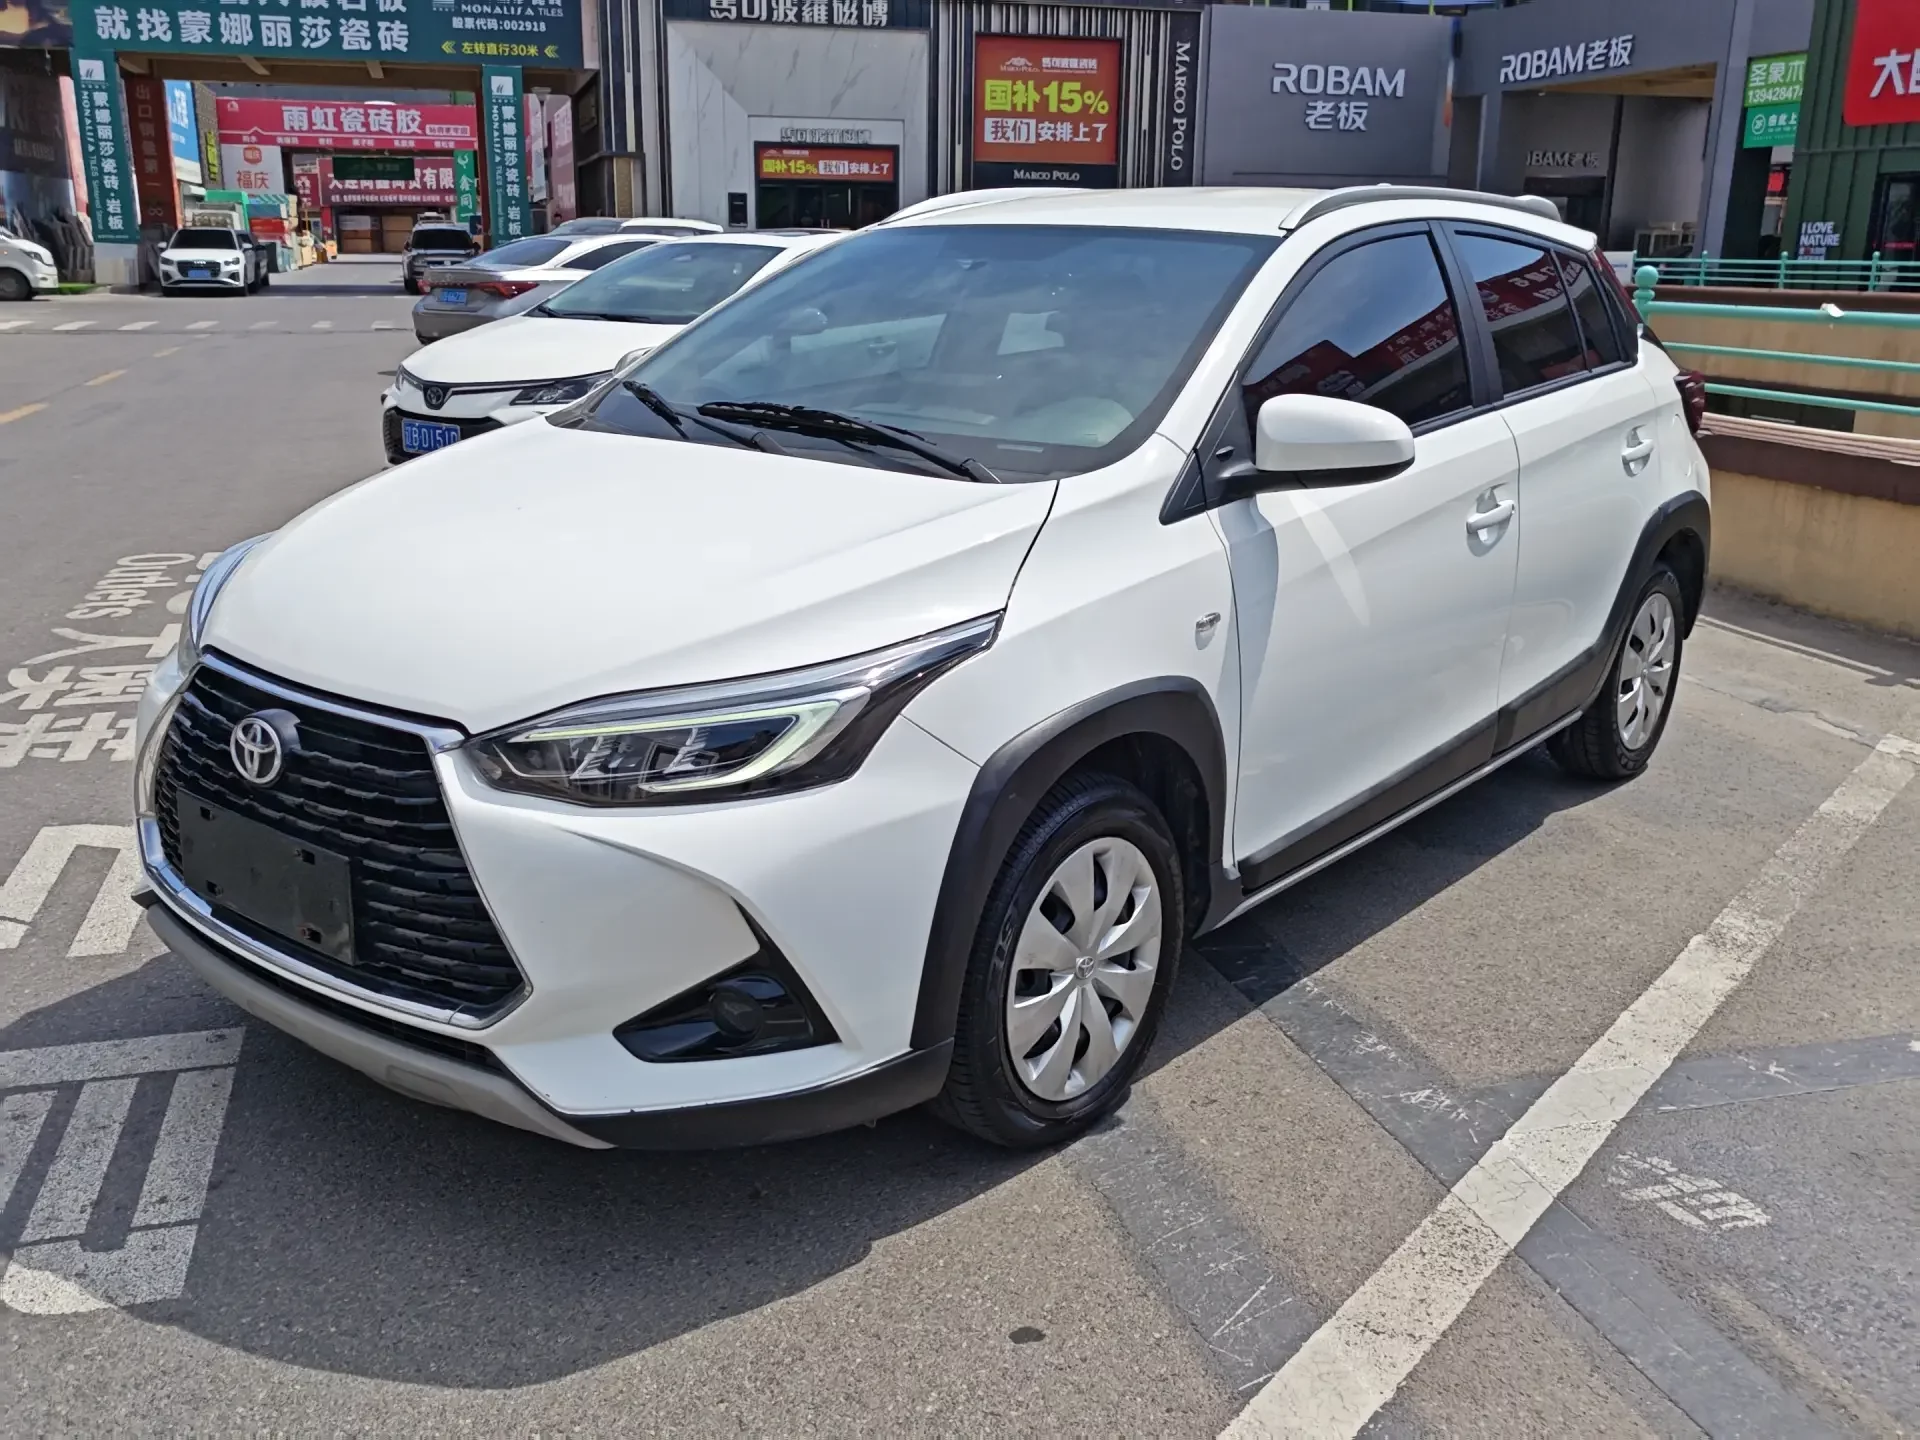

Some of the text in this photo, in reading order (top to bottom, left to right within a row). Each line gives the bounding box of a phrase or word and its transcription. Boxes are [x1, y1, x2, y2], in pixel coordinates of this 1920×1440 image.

[538, 7, 563, 17] TILES
[94, 7, 410, 53] 就找蒙娜丽莎瓷砖
[452, 17, 547, 32] 股票代码:002918
[462, 42, 539, 57] 左转直行30米
[1272, 62, 1406, 98] ROBAM
[984, 79, 1109, 115] 国补15%
[1171, 41, 1191, 170] MARCO POLO
[281, 105, 423, 134] 雨虹瓷砖胶
[1305, 100, 1369, 131] 老板
[236, 170, 270, 189] 福庆
[1013, 169, 1080, 181] MARCO POLO
[1800, 233, 1841, 246] NATURE
[1807, 221, 1835, 234] LOVE
[65, 553, 196, 619] Outlets
